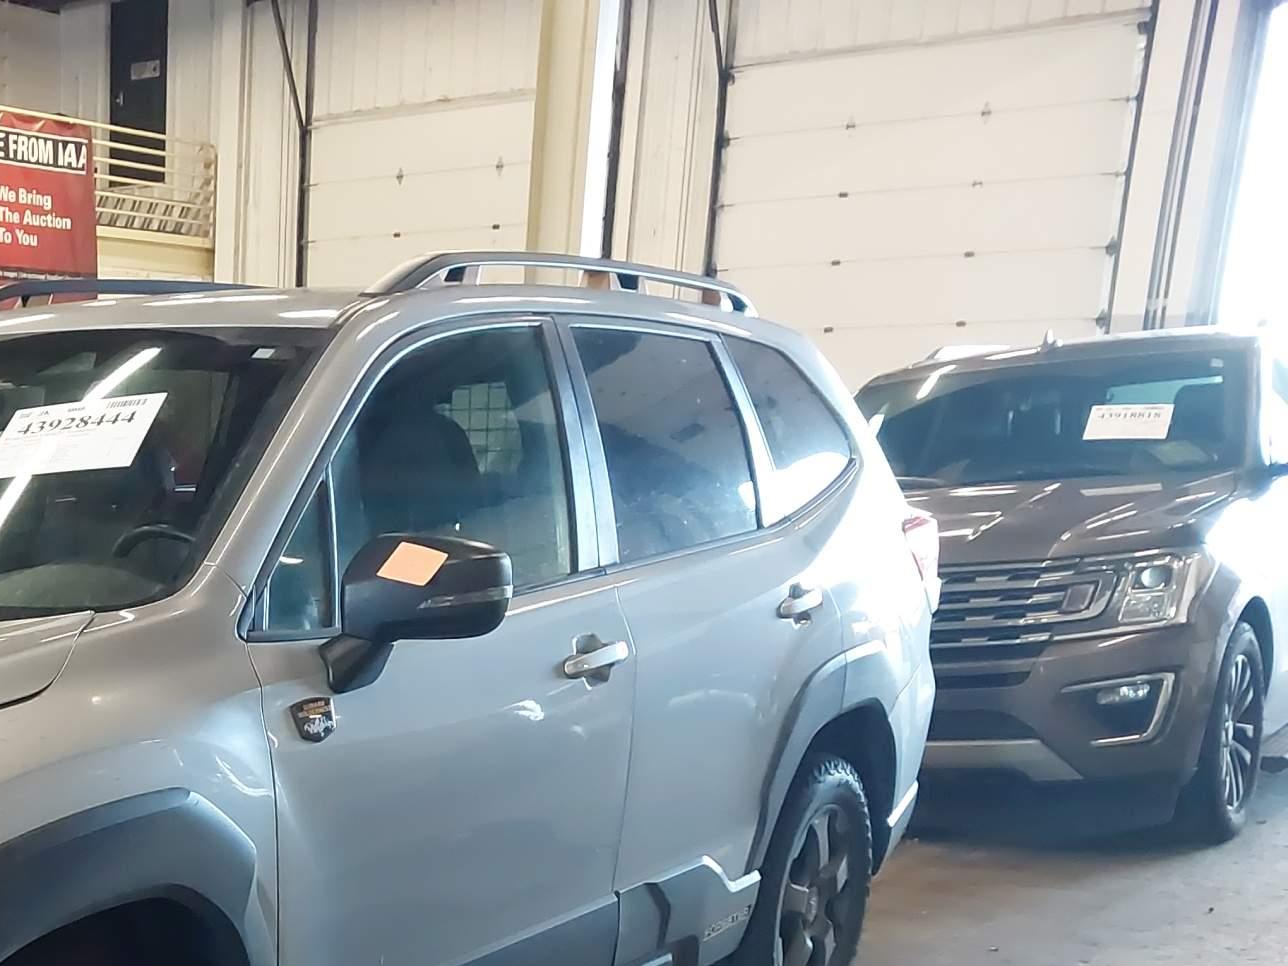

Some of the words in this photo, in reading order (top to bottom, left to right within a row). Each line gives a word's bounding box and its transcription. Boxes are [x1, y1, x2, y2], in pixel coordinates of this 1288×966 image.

[8, 134, 54, 166] FROM
[18, 187, 52, 210] Bring
[23, 209, 72, 230] Auction
[15, 229, 38, 247] You
[17, 410, 137, 435] 43928444
